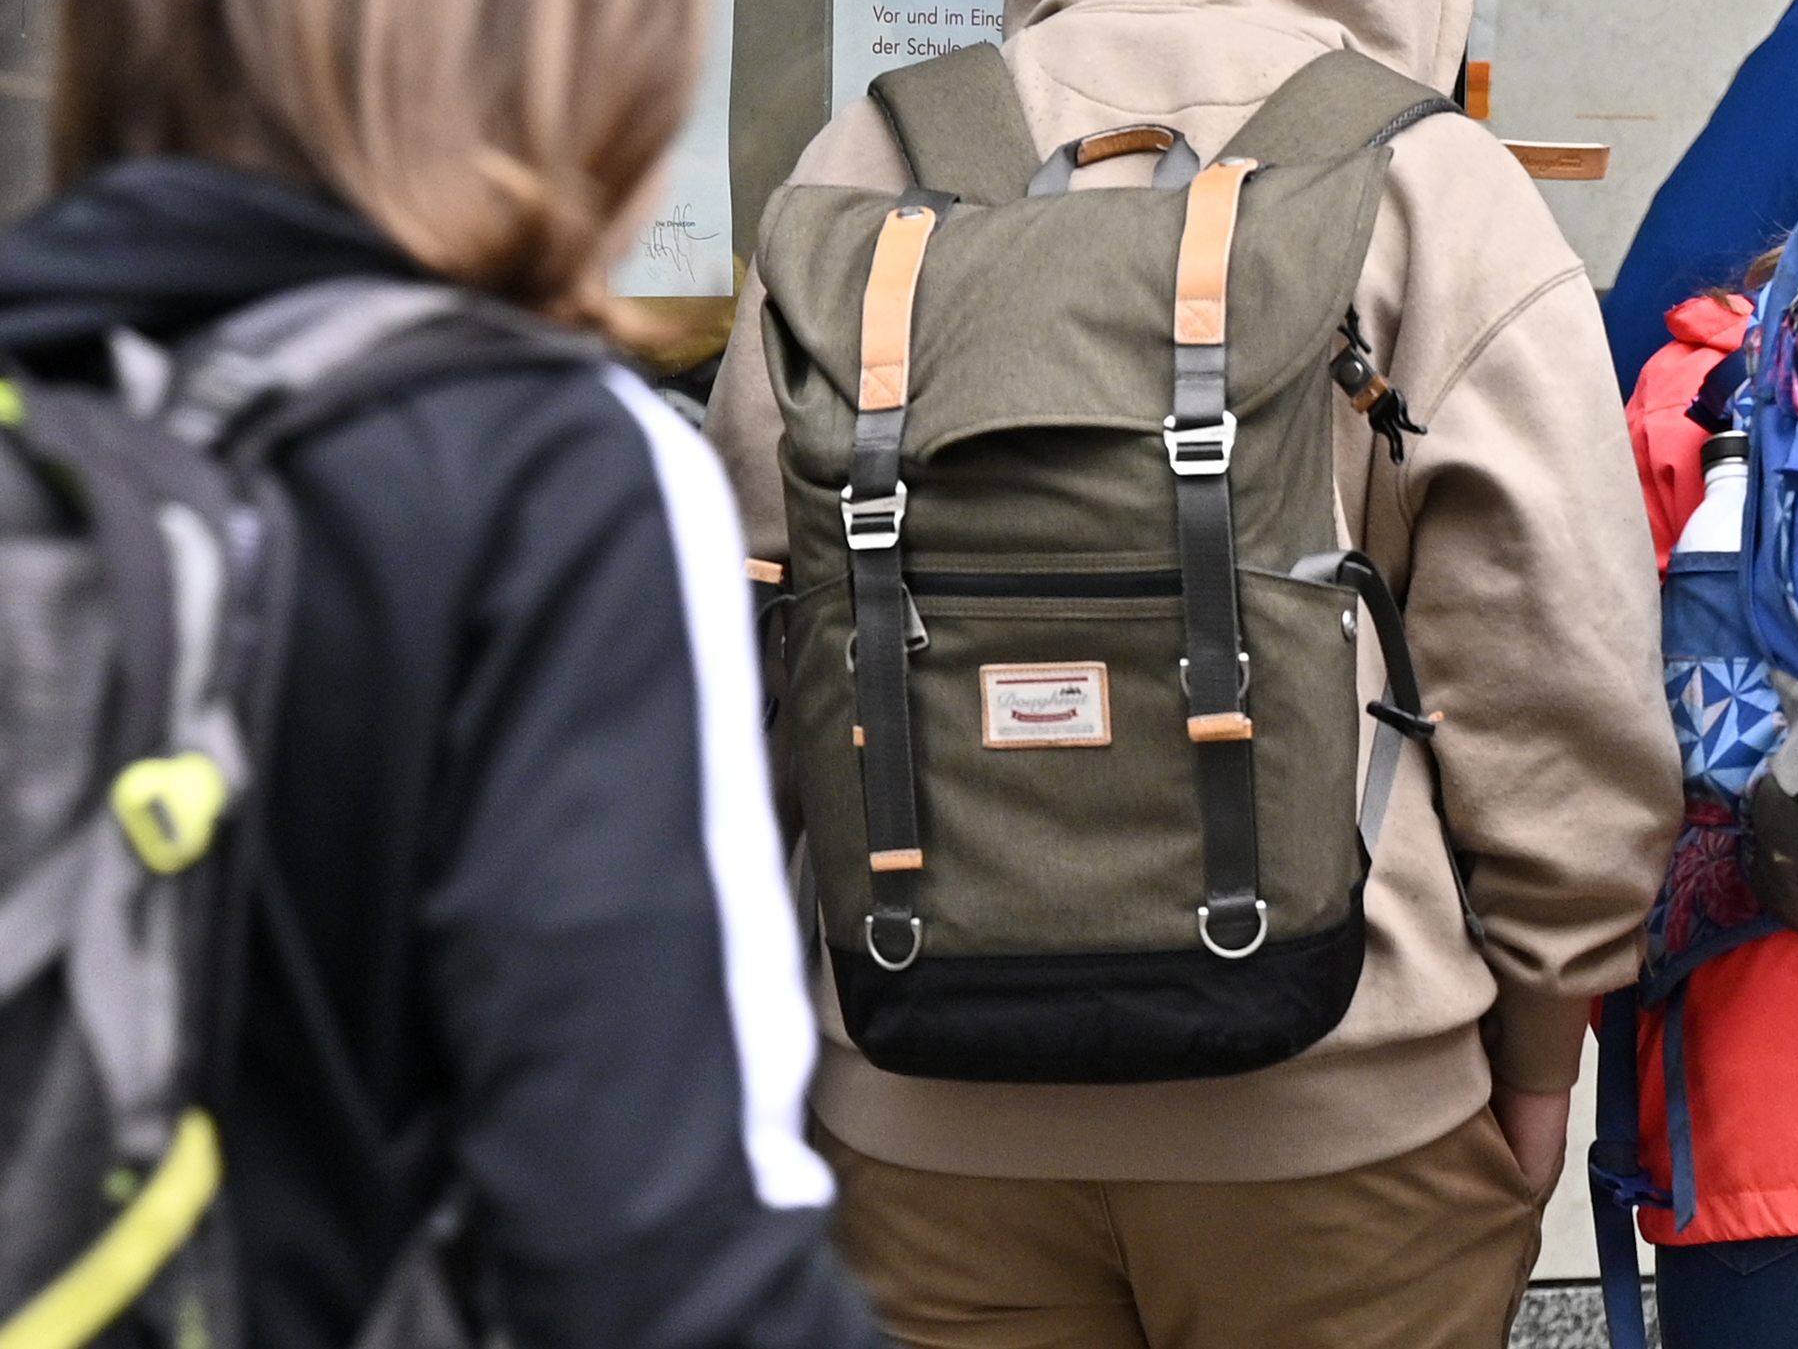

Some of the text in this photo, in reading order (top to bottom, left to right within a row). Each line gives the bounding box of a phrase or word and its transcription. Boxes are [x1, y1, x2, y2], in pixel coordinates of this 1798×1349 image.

[872, 5, 901, 24] Vor
[907, 6, 938, 25] und
[944, 8, 964, 26] im
[872, 35, 901, 56] der
